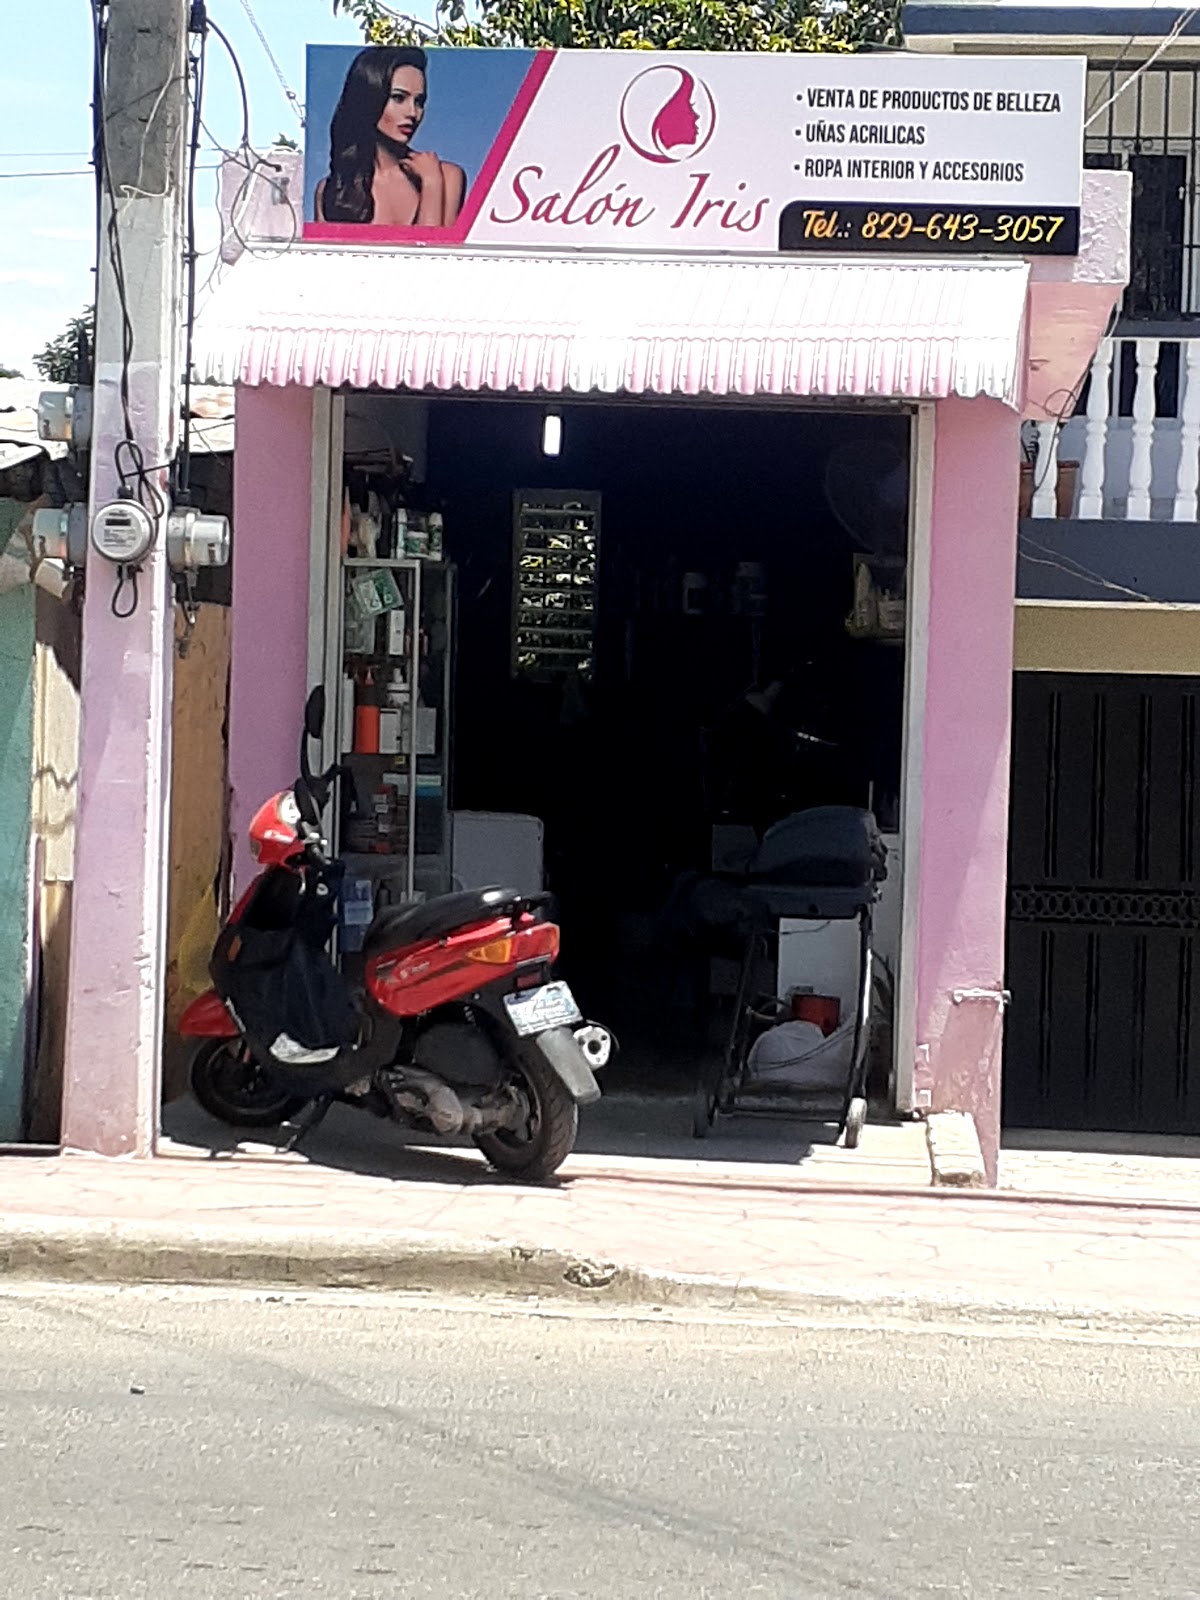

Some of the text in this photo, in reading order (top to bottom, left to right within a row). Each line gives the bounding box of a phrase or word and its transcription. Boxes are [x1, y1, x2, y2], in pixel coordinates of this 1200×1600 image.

[807, 88, 1061, 112] VENTA DE PRODUCTOS DE BELLEZA
[806, 119, 925, 145] UÑAS ACRILICAS
[804, 158, 1025, 182] ROPA INTERIOR Y ACCESORIOS
[489, 144, 770, 232] Salón Iris
[802, 210, 1065, 243] Tel.: 829-643-3057
